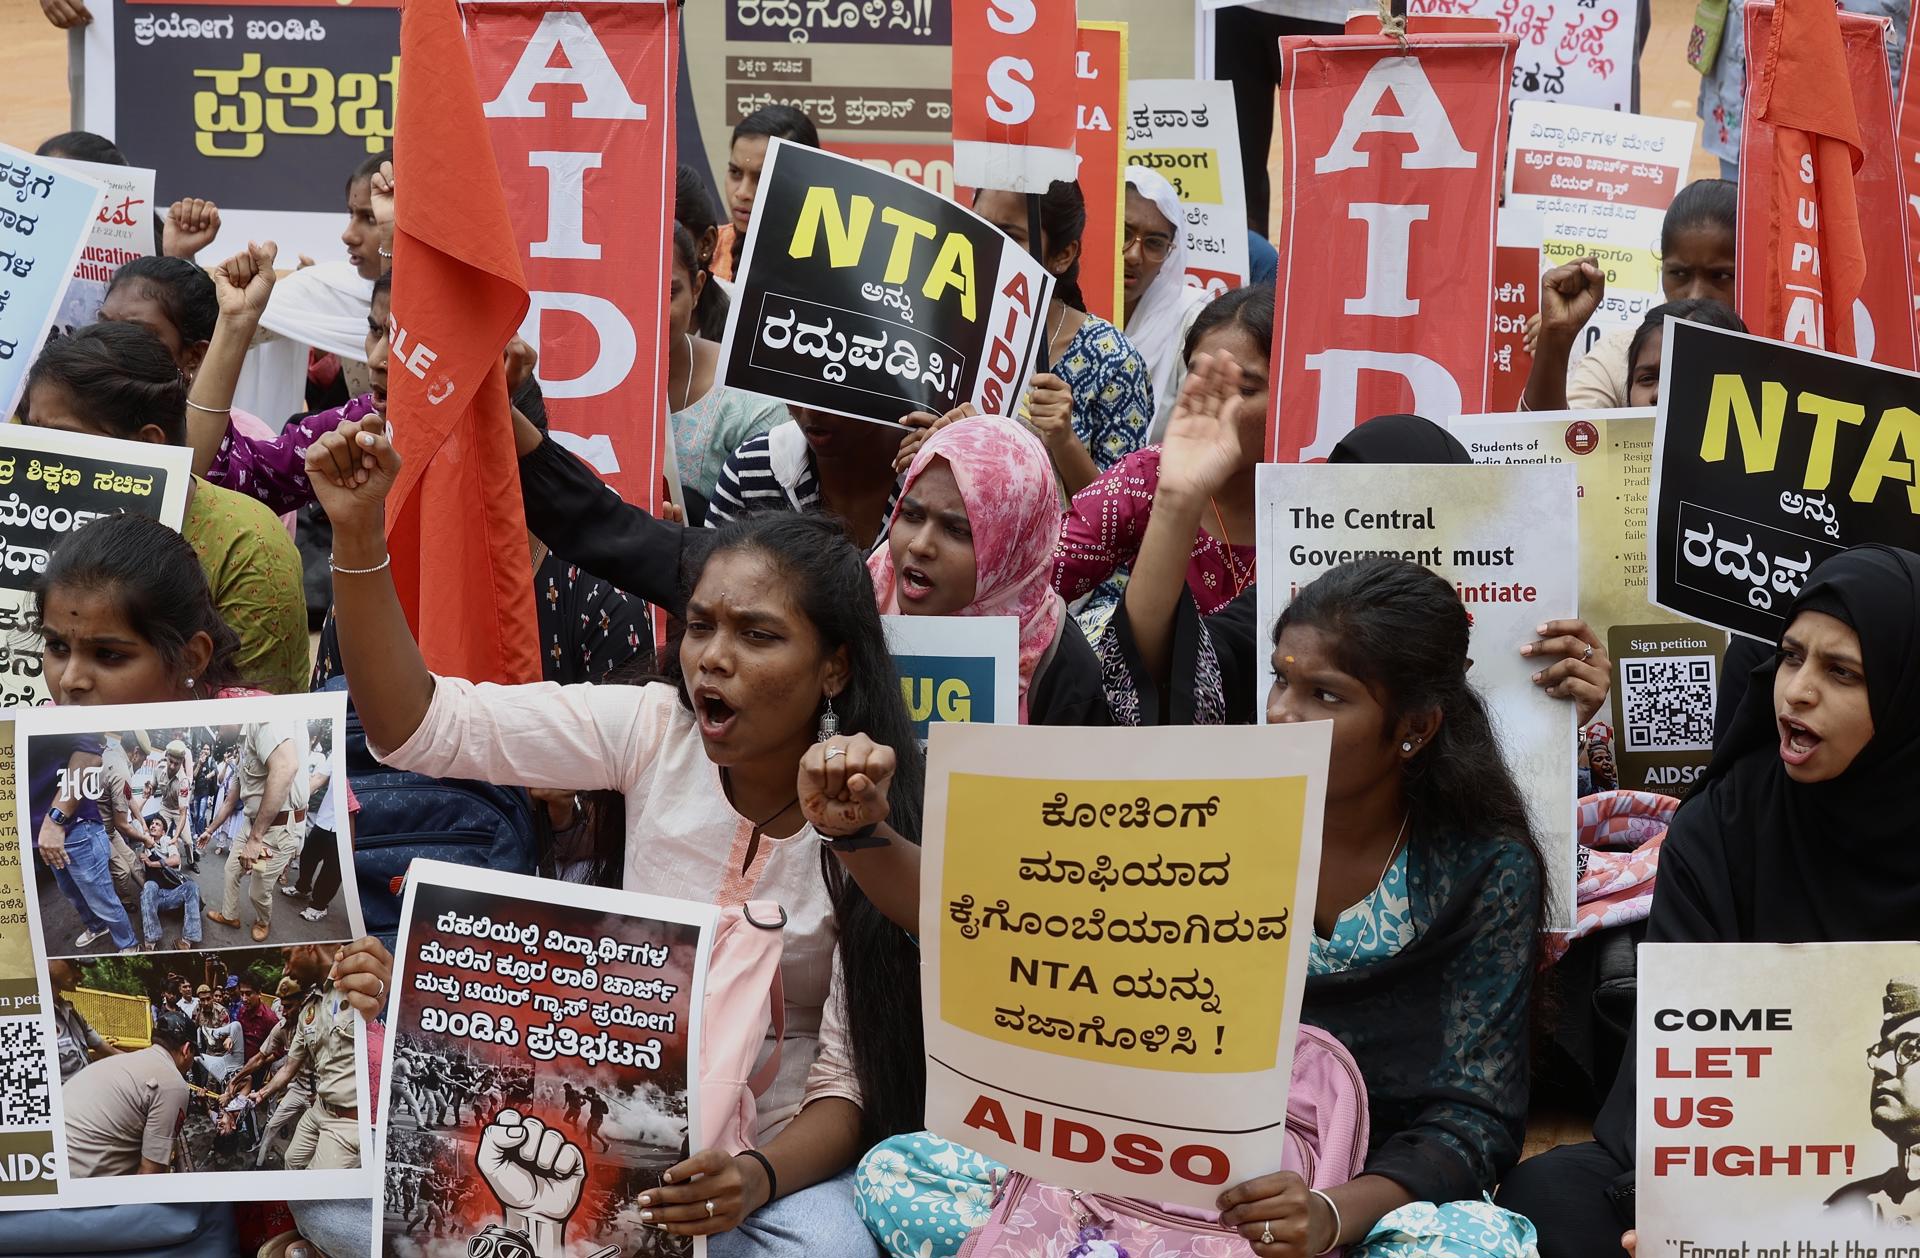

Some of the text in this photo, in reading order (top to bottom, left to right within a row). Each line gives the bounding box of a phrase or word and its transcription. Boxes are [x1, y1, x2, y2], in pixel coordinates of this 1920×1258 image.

[134, 13, 326, 45] ಪ್ರಯೋಗ ಖಂಡಿಸಿ
[737, 59, 803, 77] ಶಿಕ್ಷಣ ಸಚಿವ
[845, 97, 915, 124] ಪ್ರಧಾನ್
[1530, 123, 1666, 152] ವಿದ್ಯಾರ್ಥಿಗಳ ಮೇಲೆ
[1632, 164, 1663, 183] ಮತ್ತು
[788, 186, 976, 323] NTA
[861, 281, 914, 323] ಅನ್ನು
[762, 308, 960, 400] ರದ್ದುಪಡಿಸಿ!
[1471, 440, 1539, 453] Students of
[1550, 455, 1562, 464] to
[1699, 374, 1920, 515] NTA
[26, 459, 81, 494] ಶಿಕ್ಷಣ
[93, 469, 153, 496] ಸಚಿವ
[1623, 493, 1647, 502] Take
[1779, 490, 1840, 539] ಅನ್ನು
[1289, 507, 1436, 530] The Central
[1453, 546, 1514, 566] must
[1456, 581, 1537, 603] intiate
[1630, 638, 1707, 652] Sign petition
[1041, 792, 1221, 830] ಕೋಚಿಂಗ್
[1019, 851, 1231, 892] ಮಾಫಿಯಾದ
[949, 894, 1290, 945] ಕೈಗೊಂಬೆಯಾಗಿರುವ
[437, 911, 668, 967] ದೆಹಲಿಯಲ್ಲಿ ವಿದ್ಯಾರ್ಥಿಗಳ
[419, 942, 677, 1003] ಮೇಲಿನ ಕ್ರೂರ ಲಾಠಿ ಚಾರ್ಜ್
[1009, 956, 1223, 1016] NTA ಯನ್ನು
[414, 973, 675, 1033] ಮತ್ತು ಟಿಯರ್ ಗ್ಯಾಸ್ ಪ್ರಯೋಗ
[1653, 1008, 1793, 1032] COME
[420, 1007, 661, 1071] ಖಂಡಿಸಿ ಪ್ರತಿಭಟನೆ
[994, 1006, 1198, 1056] ವಜಾಗೊಳಿಸಿ
[1655, 1047, 1772, 1078] LET
[1653, 1096, 1734, 1128] US
[962, 1094, 1231, 1186] AIDSO
[1654, 1144, 1855, 1176] FIGHT!
